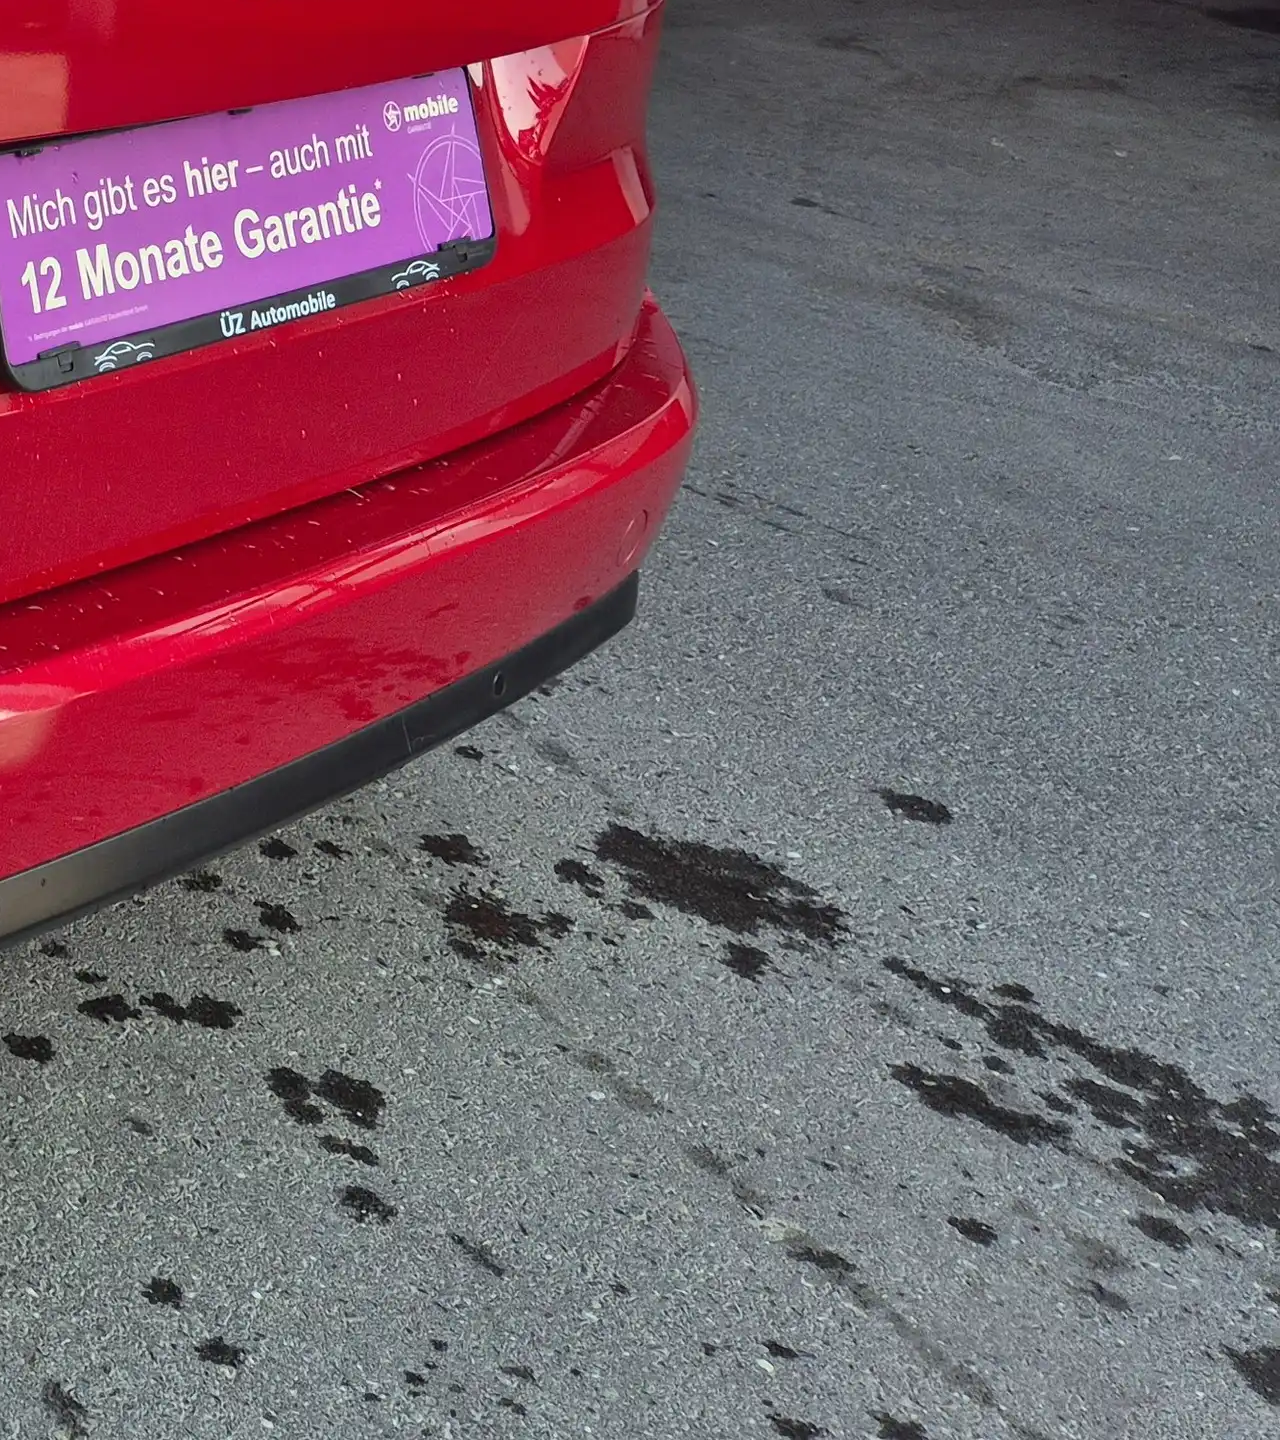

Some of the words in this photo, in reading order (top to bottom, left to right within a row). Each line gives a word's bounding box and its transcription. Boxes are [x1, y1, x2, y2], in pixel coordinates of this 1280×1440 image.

[403, 94, 459, 123] mobile
[6, 189, 77, 239] Mich
[83, 174, 138, 231] gibt
[143, 174, 177, 208] es
[182, 156, 239, 198] hier
[269, 133, 331, 179] auch
[335, 123, 374, 164] mit
[20, 256, 68, 315] 12
[75, 224, 225, 301] Monate
[220, 311, 246, 338] ÜZ
[250, 290, 336, 330] Automobile
